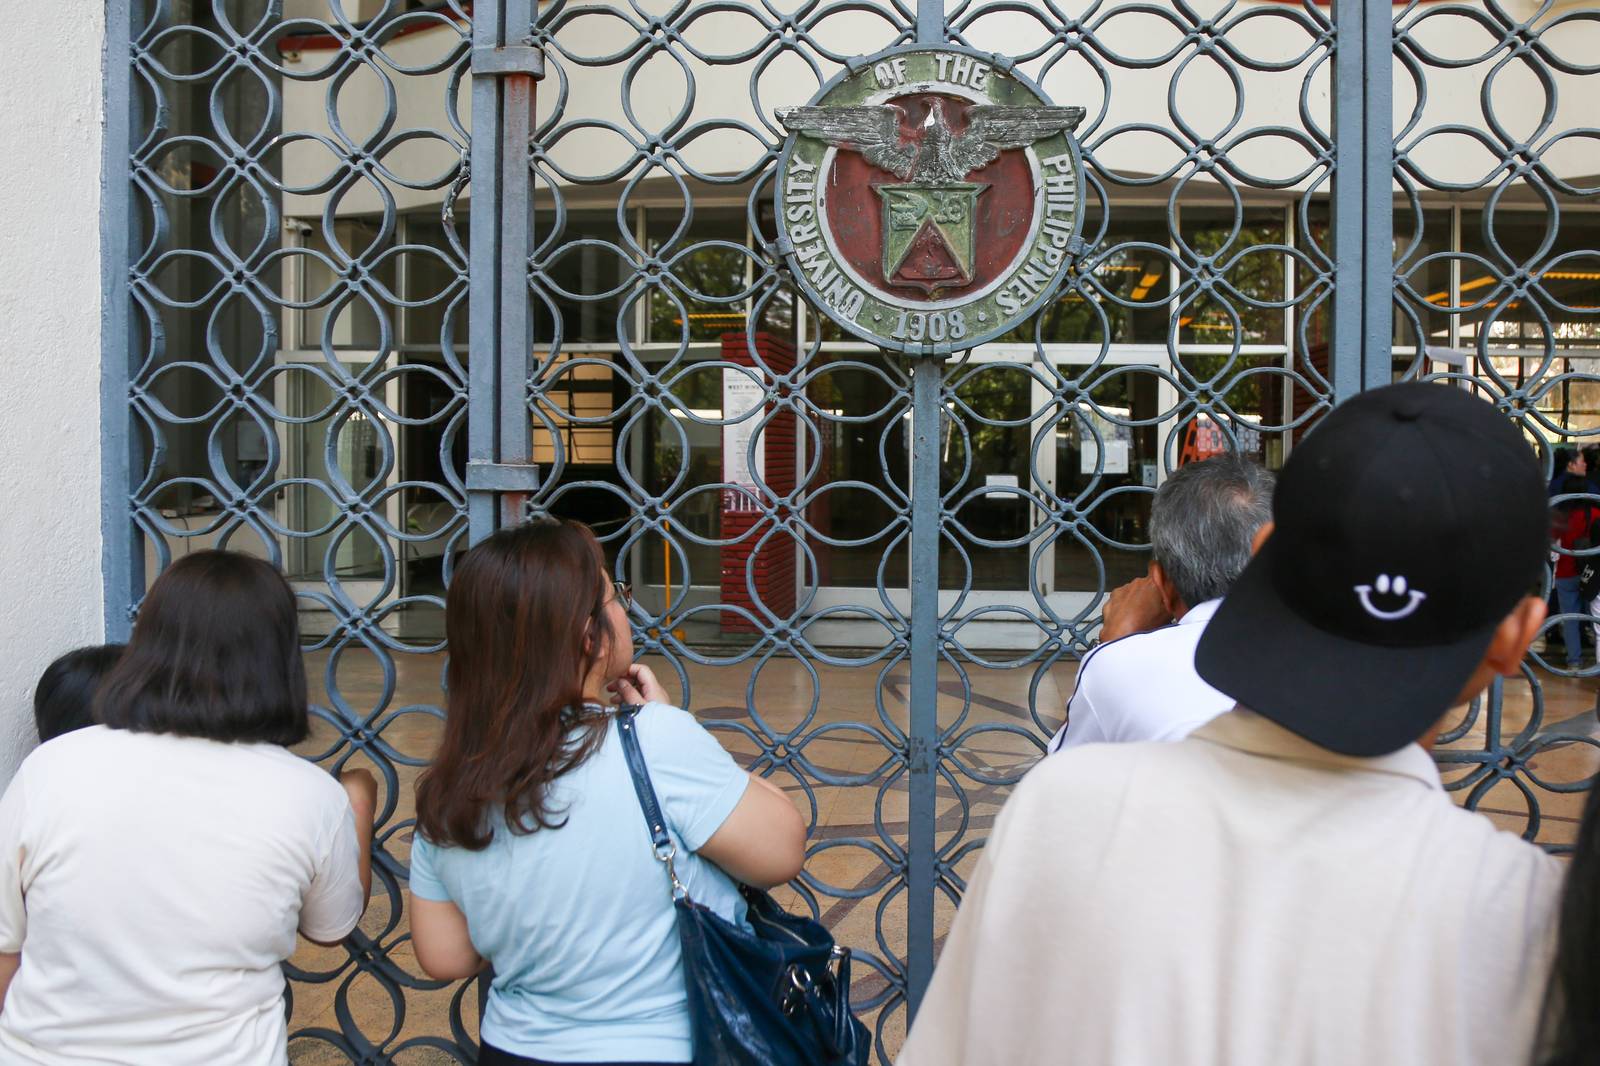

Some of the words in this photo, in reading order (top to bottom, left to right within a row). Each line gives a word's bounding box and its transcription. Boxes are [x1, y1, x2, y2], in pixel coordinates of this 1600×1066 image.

[786, 154, 864, 321] UNIVERSITY
[874, 58, 907, 87] OF
[935, 53, 990, 90] THE
[995, 154, 1076, 315] PHILIPPINES
[895, 311, 967, 342] 1908
